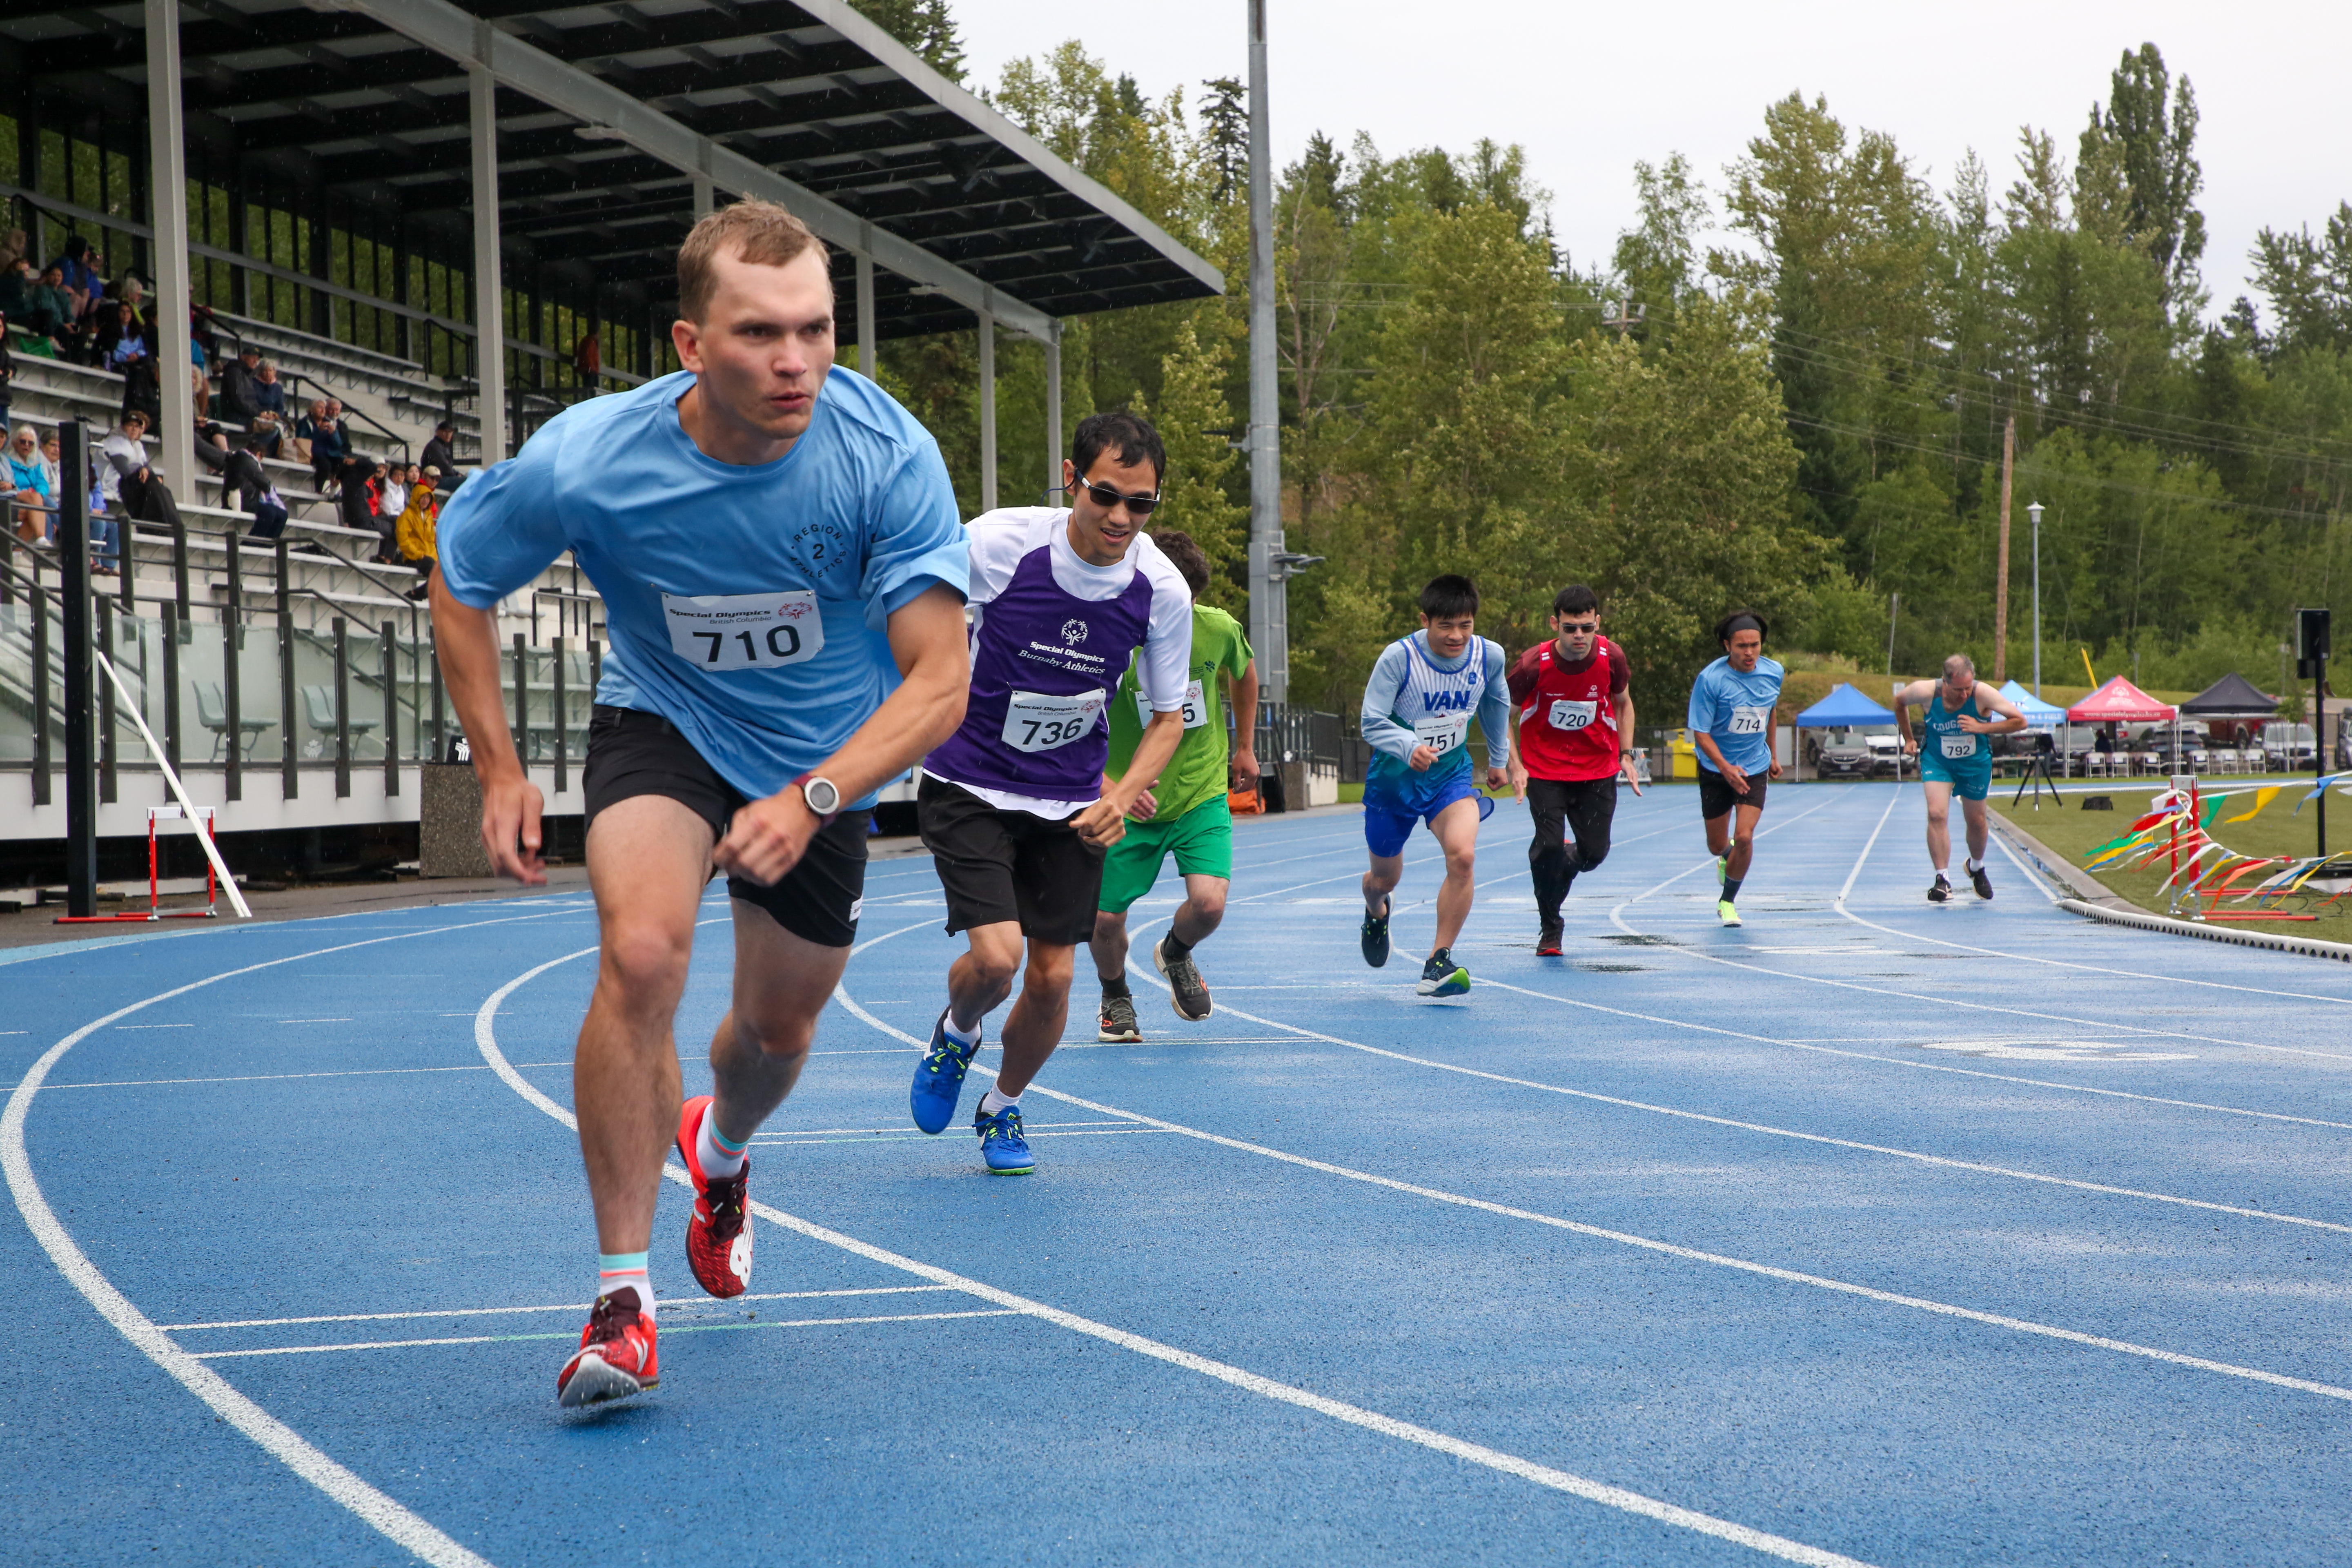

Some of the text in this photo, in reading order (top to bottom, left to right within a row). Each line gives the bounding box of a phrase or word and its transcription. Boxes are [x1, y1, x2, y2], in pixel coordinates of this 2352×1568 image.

[793, 524, 842, 542] REGION
[813, 543, 824, 559] 2
[789, 551, 846, 578] ATHLETICS
[669, 609, 771, 618] Special Olympics
[692, 625, 800, 662] 710
[1030, 641, 1105, 663] Special Olympics
[1018, 649, 1105, 674] Burnaby Athletics
[1423, 690, 1470, 711] VAN
[1557, 712, 1587, 727] 720
[1737, 719, 1760, 732] 714
[1022, 717, 1083, 745] 736
[1424, 731, 1456, 751] 751
[1947, 746, 1970, 756] 792
